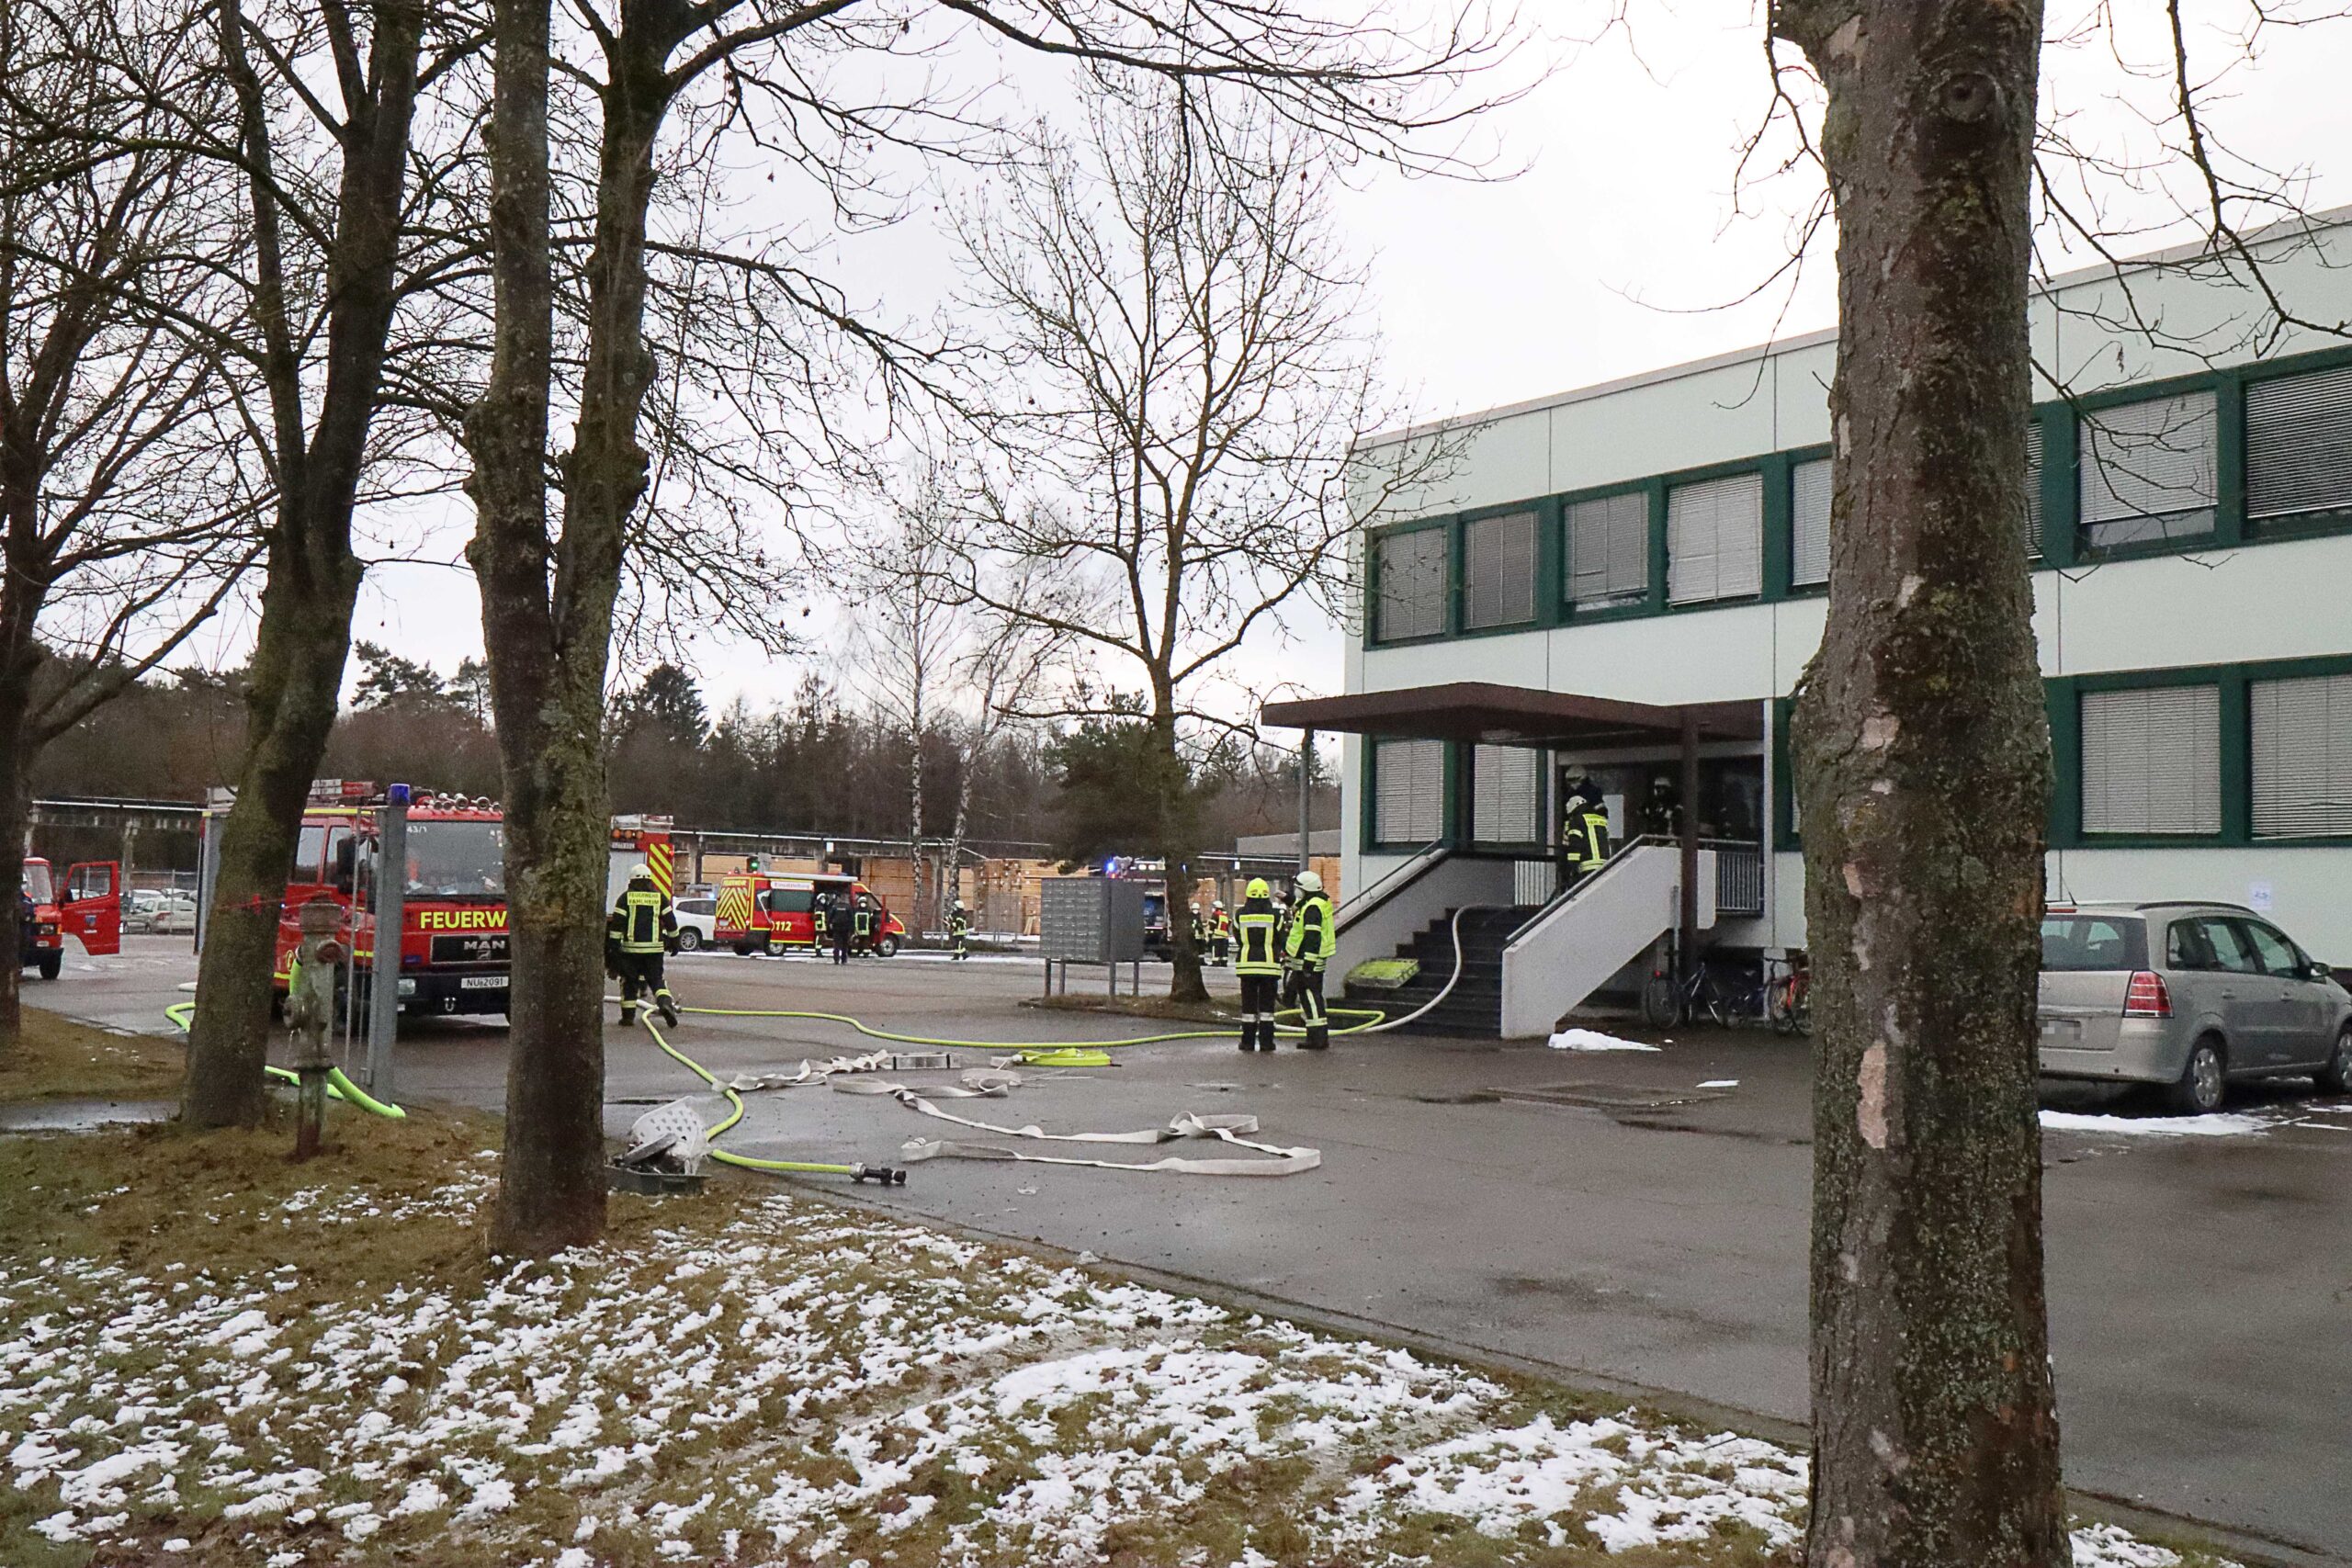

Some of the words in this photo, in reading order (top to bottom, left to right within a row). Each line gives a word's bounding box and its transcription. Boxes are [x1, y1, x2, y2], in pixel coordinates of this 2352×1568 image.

[420, 910, 507, 929] FEUERW
[775, 921, 792, 931] 112
[464, 941, 505, 950] MAN
